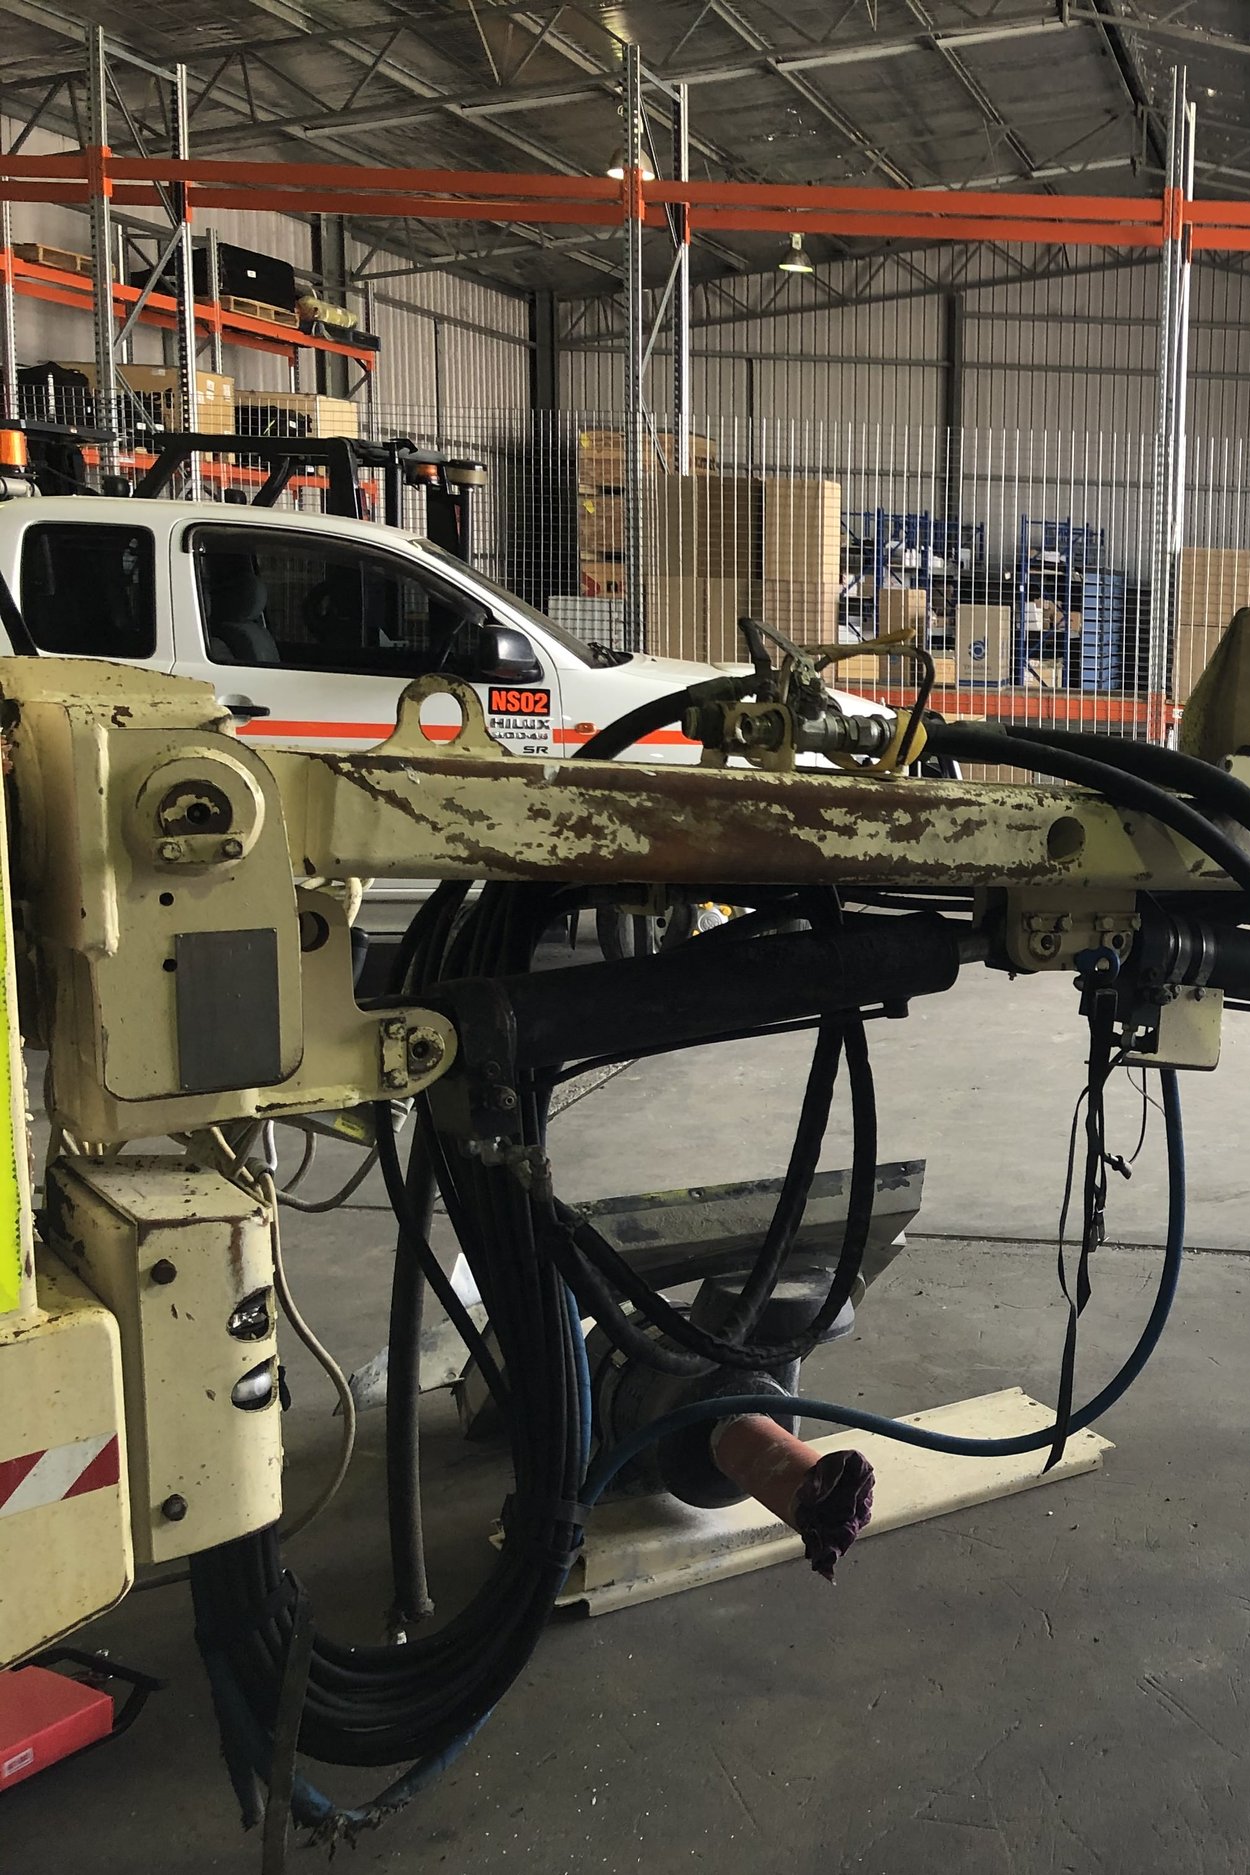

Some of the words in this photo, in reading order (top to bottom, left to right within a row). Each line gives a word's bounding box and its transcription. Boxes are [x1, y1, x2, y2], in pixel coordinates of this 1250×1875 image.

[491, 690, 548, 713] NS02
[490, 718, 550, 730] HILUX
[523, 746, 549, 754] SR
